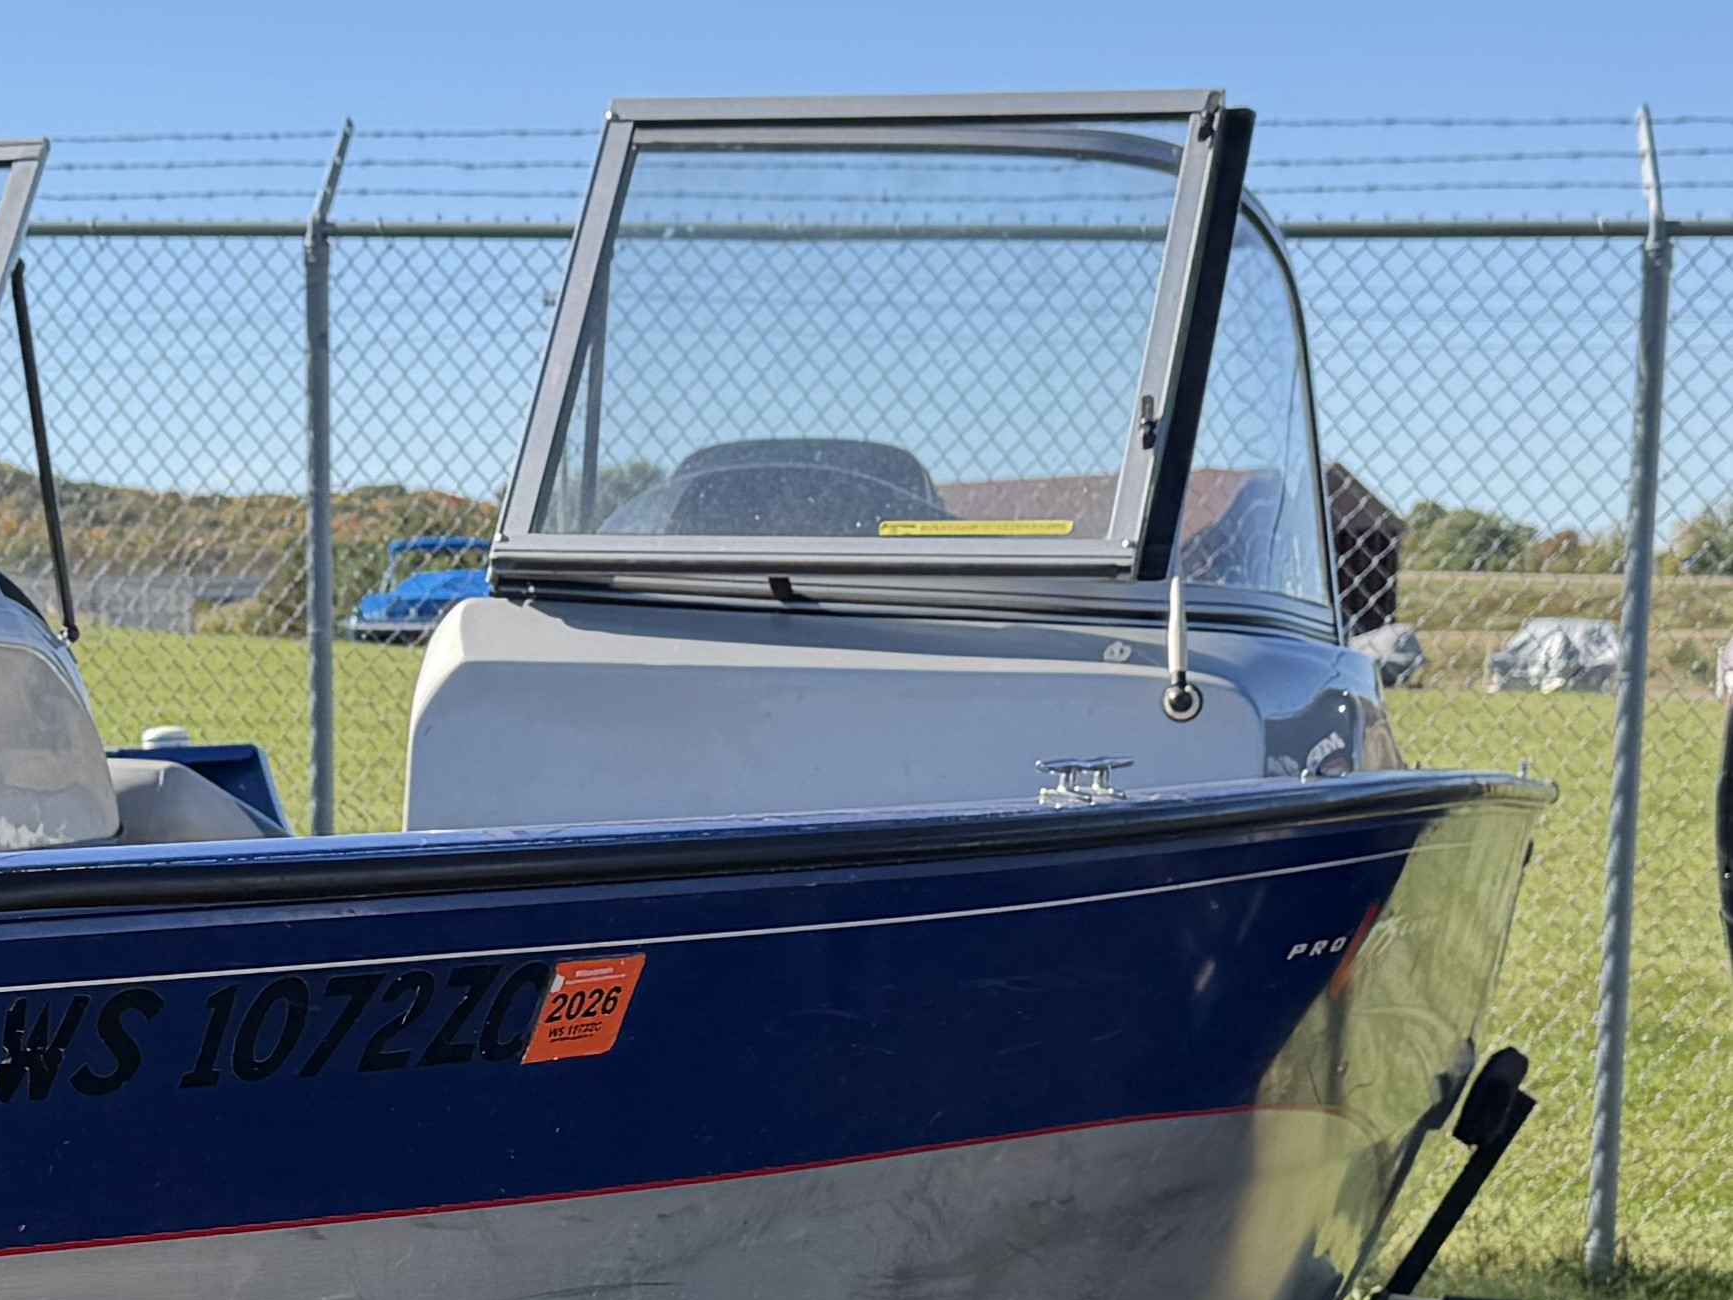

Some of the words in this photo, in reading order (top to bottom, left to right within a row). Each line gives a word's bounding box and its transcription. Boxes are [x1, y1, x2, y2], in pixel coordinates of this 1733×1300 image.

[1286, 936, 1347, 960] PRO
[544, 986, 622, 1023] 2026
[176, 961, 550, 1090] 1072ZC
